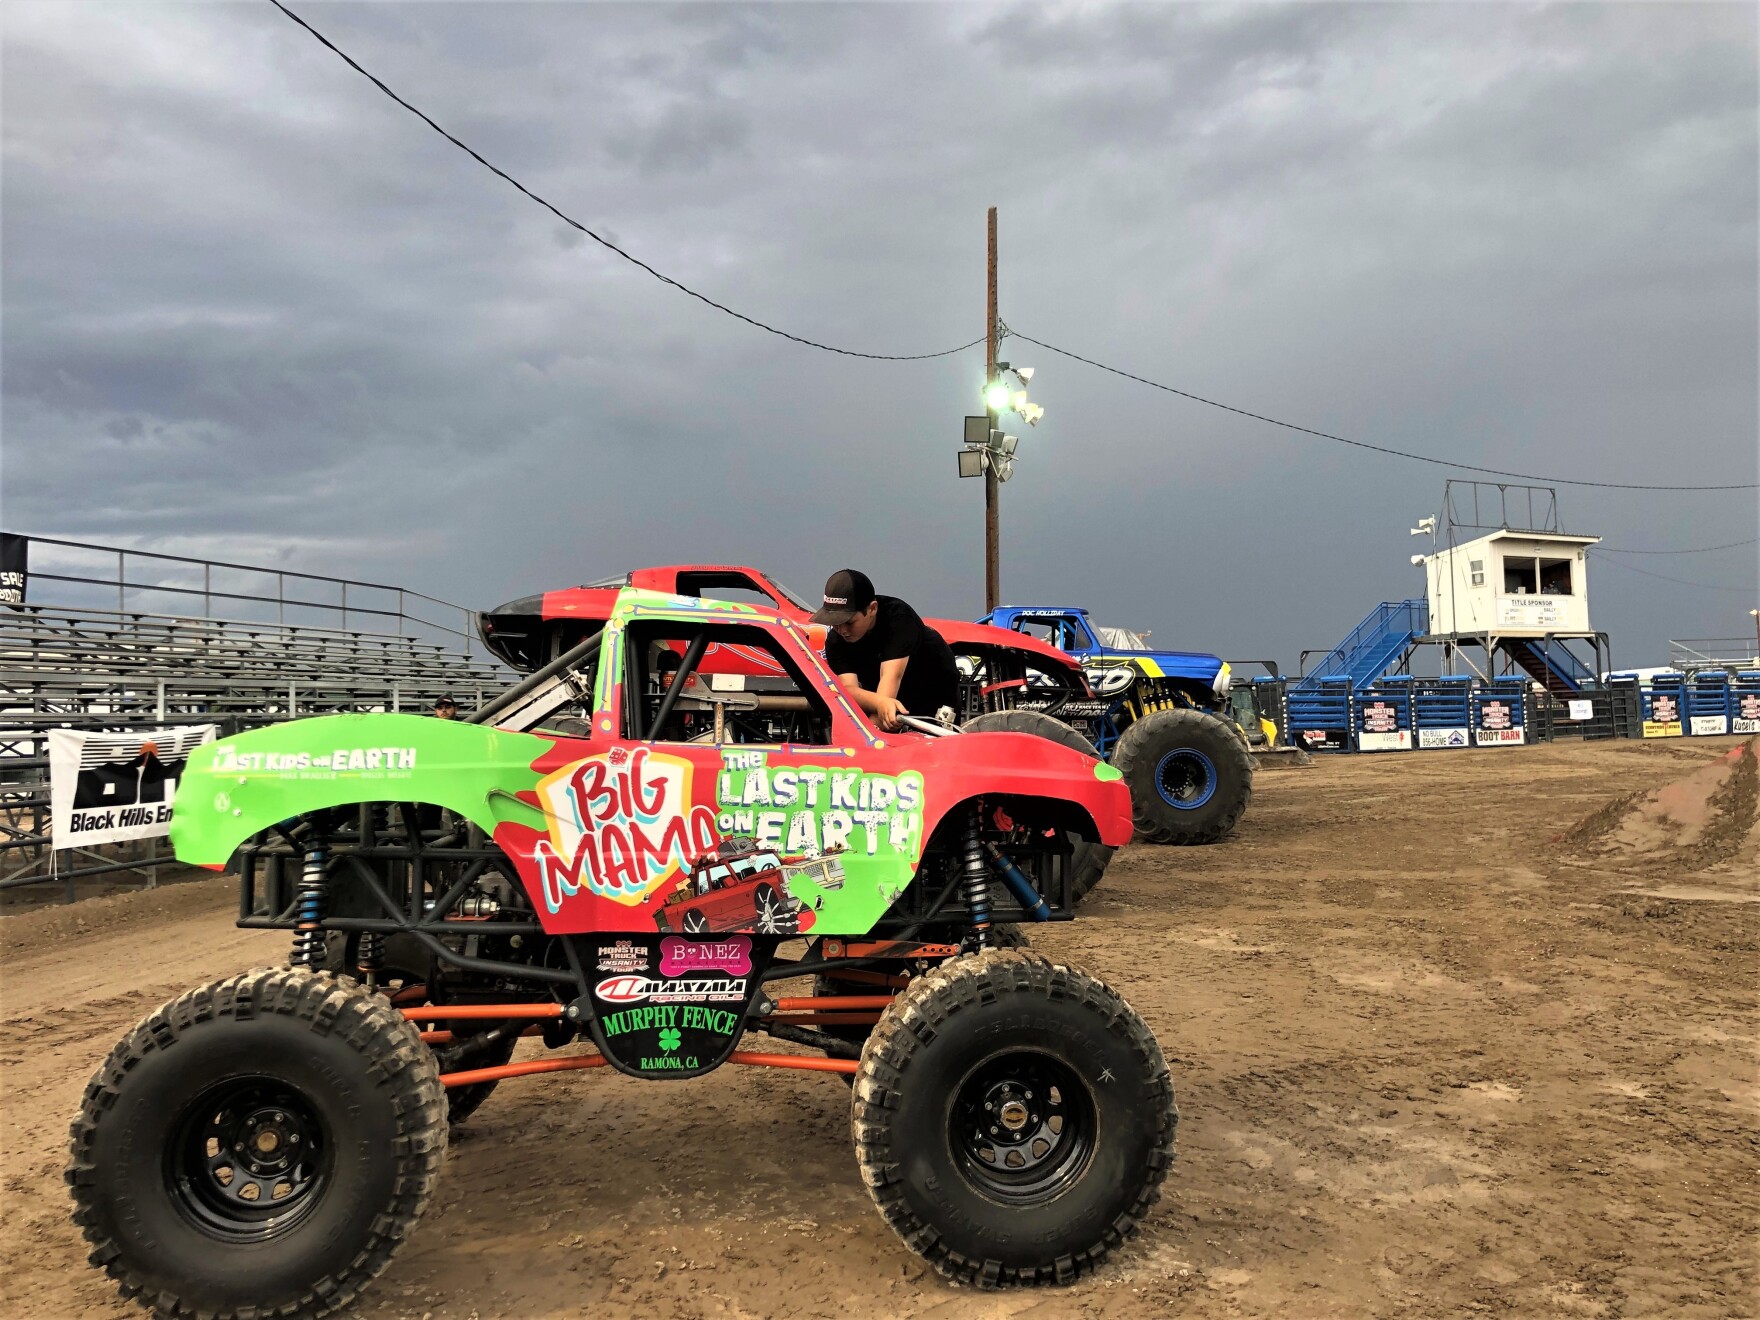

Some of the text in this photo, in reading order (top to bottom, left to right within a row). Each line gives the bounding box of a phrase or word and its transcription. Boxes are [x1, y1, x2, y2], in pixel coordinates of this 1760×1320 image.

[1364, 708, 1395, 717] MONSTER
[1478, 730, 1520, 741] BOOT BARN
[213, 752, 263, 771] LAST
[265, 752, 311, 770] KIDS
[332, 748, 416, 771] EARTH
[720, 768, 920, 811] LAST KIDS
[70, 811, 115, 833] Black
[119, 807, 153, 828] Hills
[756, 810, 920, 858] EARTH
[535, 805, 722, 908] MAMA
[598, 946, 648, 956] MONSTER
[635, 978, 747, 994] MAXIMA
[649, 994, 744, 1003] RACING OILS
[602, 1006, 738, 1038] MURPHY FENCE
[641, 1056, 699, 1071] RAMONA, CA
